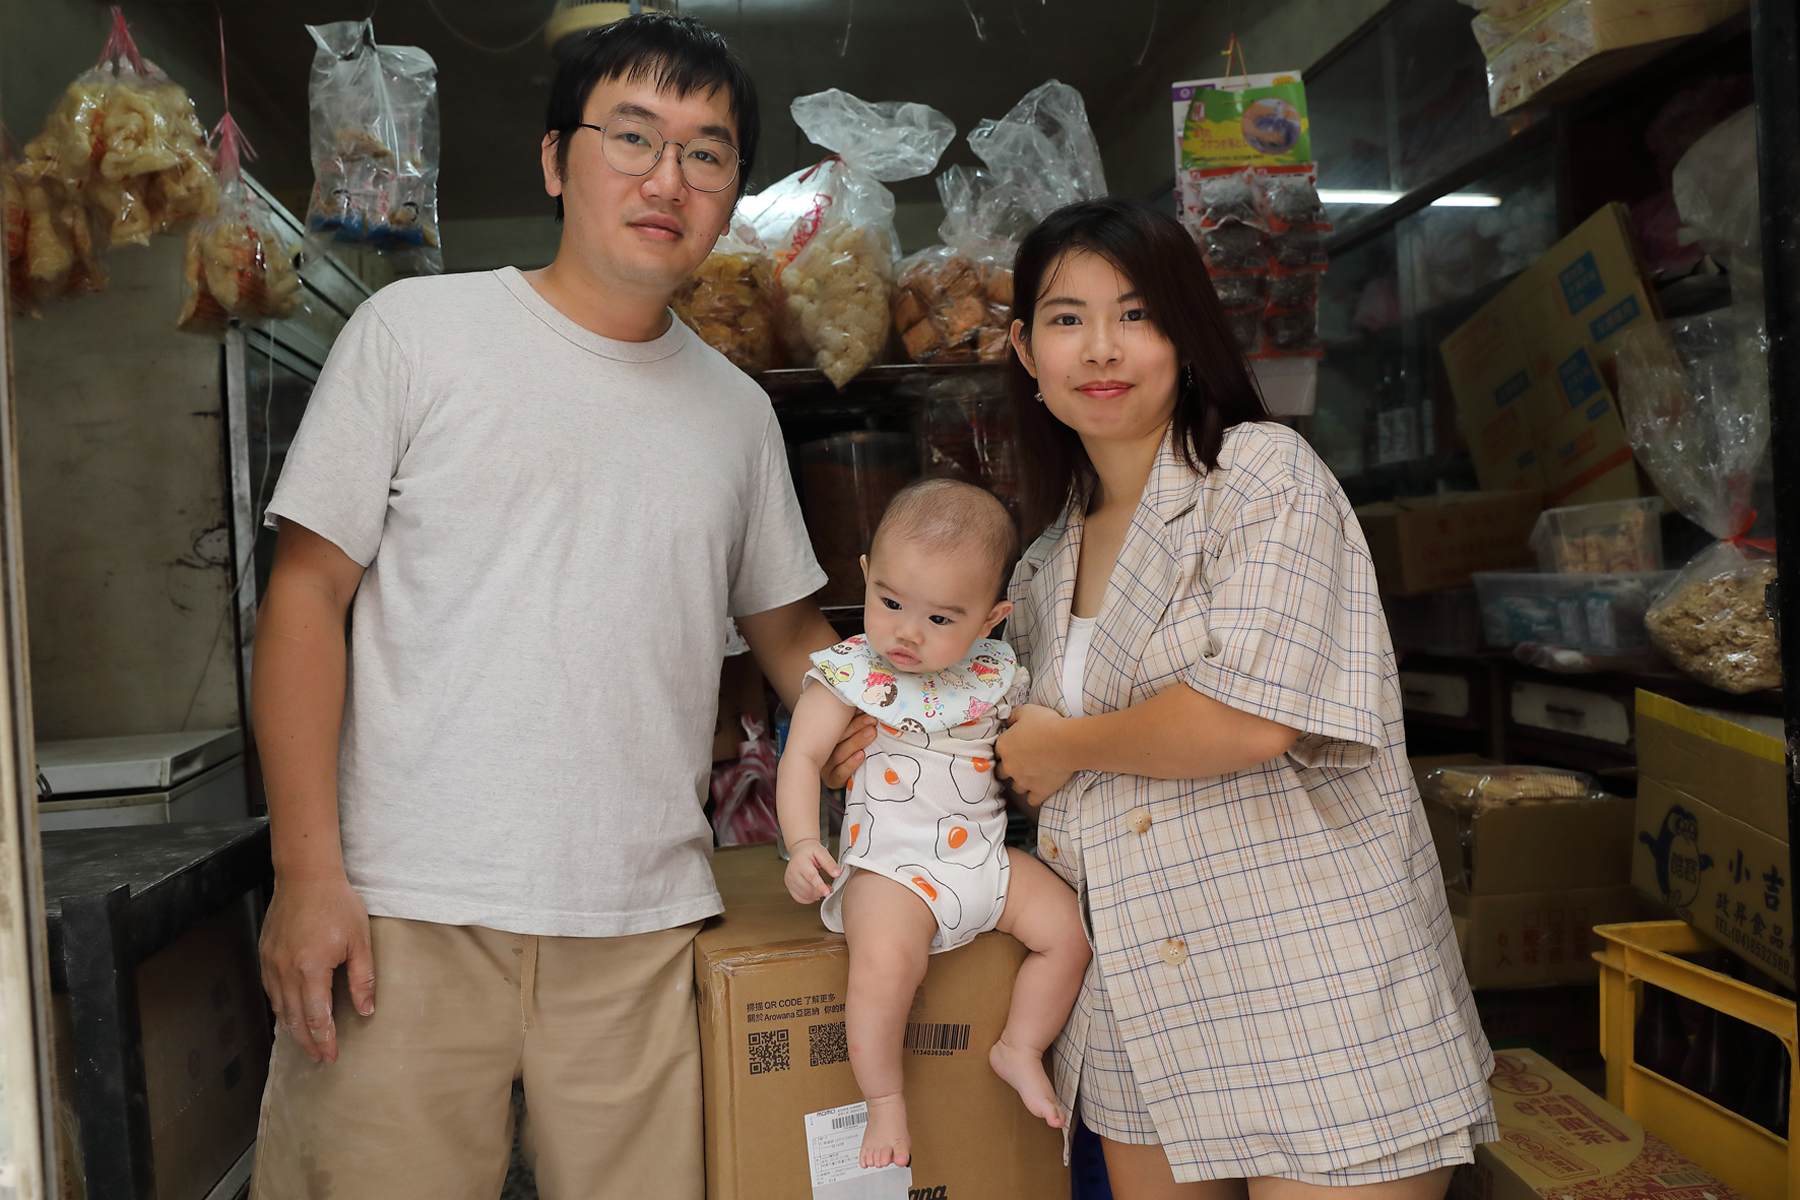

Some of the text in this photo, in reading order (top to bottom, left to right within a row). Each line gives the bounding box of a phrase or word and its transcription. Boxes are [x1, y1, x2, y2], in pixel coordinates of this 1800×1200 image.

[922, 680, 936, 718] CRAYON
[1729, 848, 1785, 912] 小吉
[746, 993, 836, 1012] 掃描 QR CODE 了解更多
[747, 1012, 764, 1023] 關於
[764, 1011, 795, 1022] Arowana
